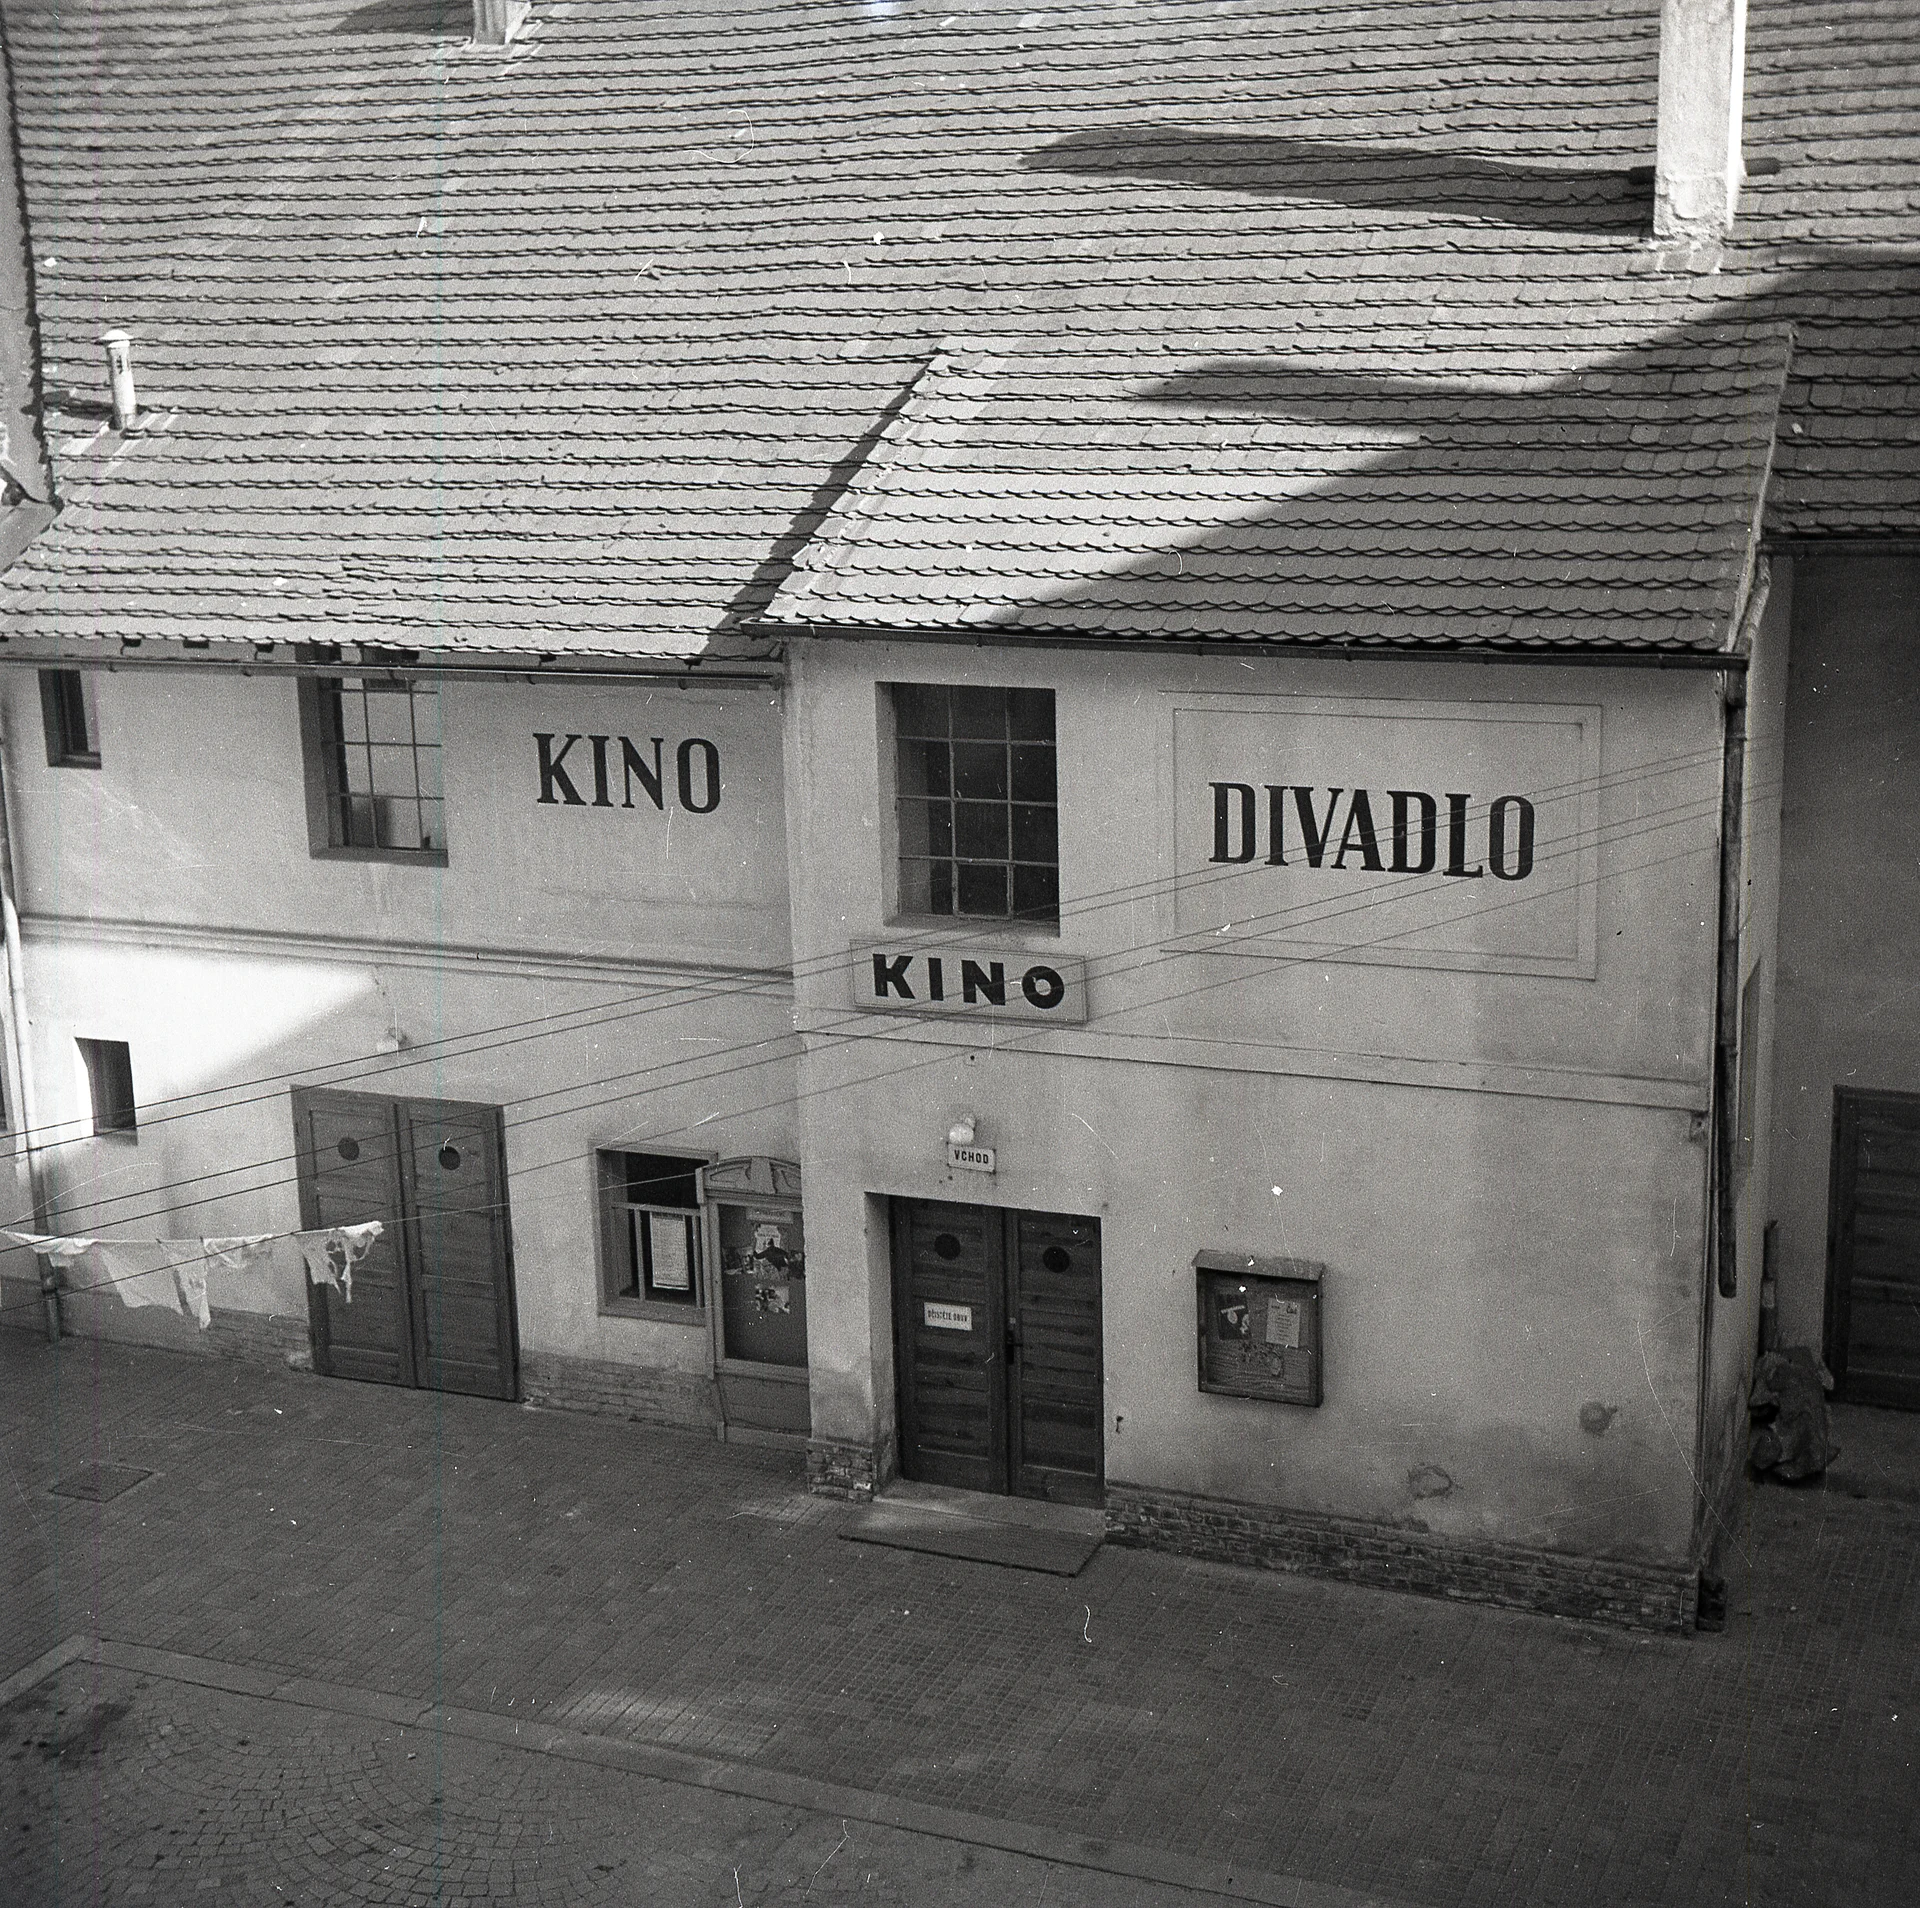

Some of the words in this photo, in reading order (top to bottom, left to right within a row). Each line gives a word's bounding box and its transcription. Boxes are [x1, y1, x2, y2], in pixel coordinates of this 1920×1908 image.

[533, 733, 720, 814] KINO
[1208, 782, 1535, 881] DIVADLO
[872, 953, 1065, 1009] KINO
[954, 1149, 989, 1164] VCHOD
